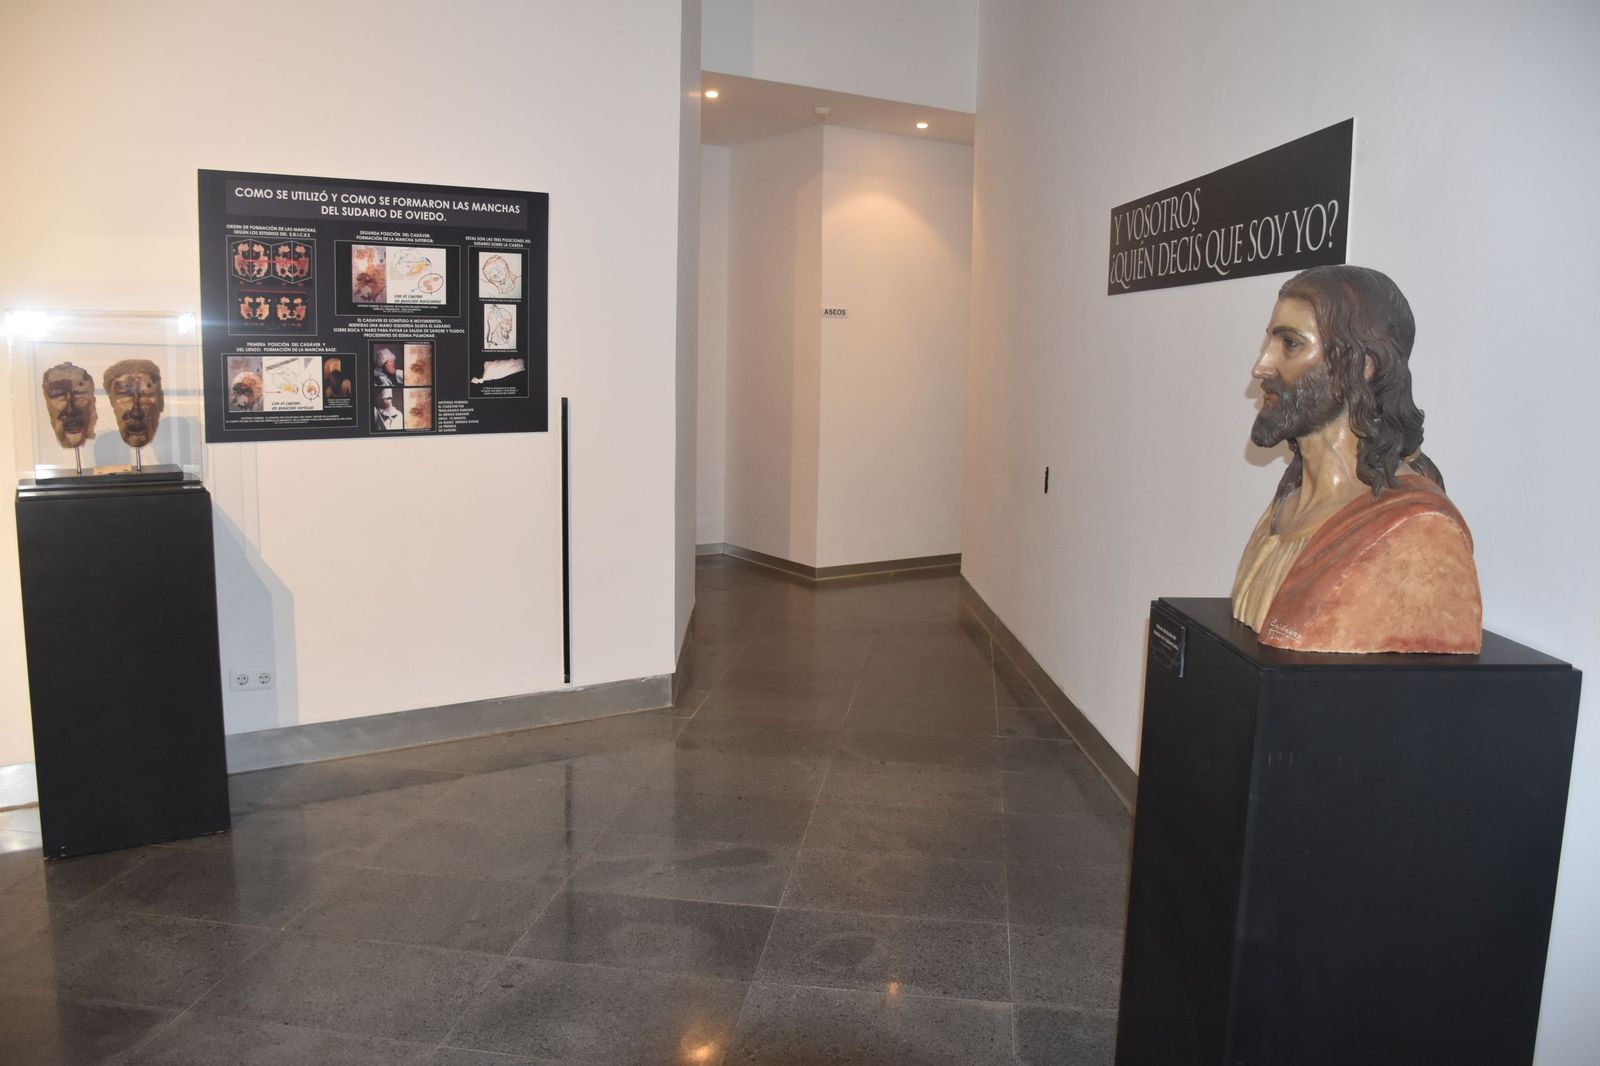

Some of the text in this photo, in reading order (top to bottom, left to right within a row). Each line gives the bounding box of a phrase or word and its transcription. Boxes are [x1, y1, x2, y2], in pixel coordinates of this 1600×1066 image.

[235, 187, 520, 214] COMO SE UTILIZÓ Y COMO SE FORMARON LAS MANCHAS
[321, 206, 447, 222] DEL SUDARIO DE OVIEDO.
[1114, 187, 1201, 245] Y VOSOTROS
[1110, 200, 1339, 289] ¿QUIÉN DECÍS QUE SOY YO?
